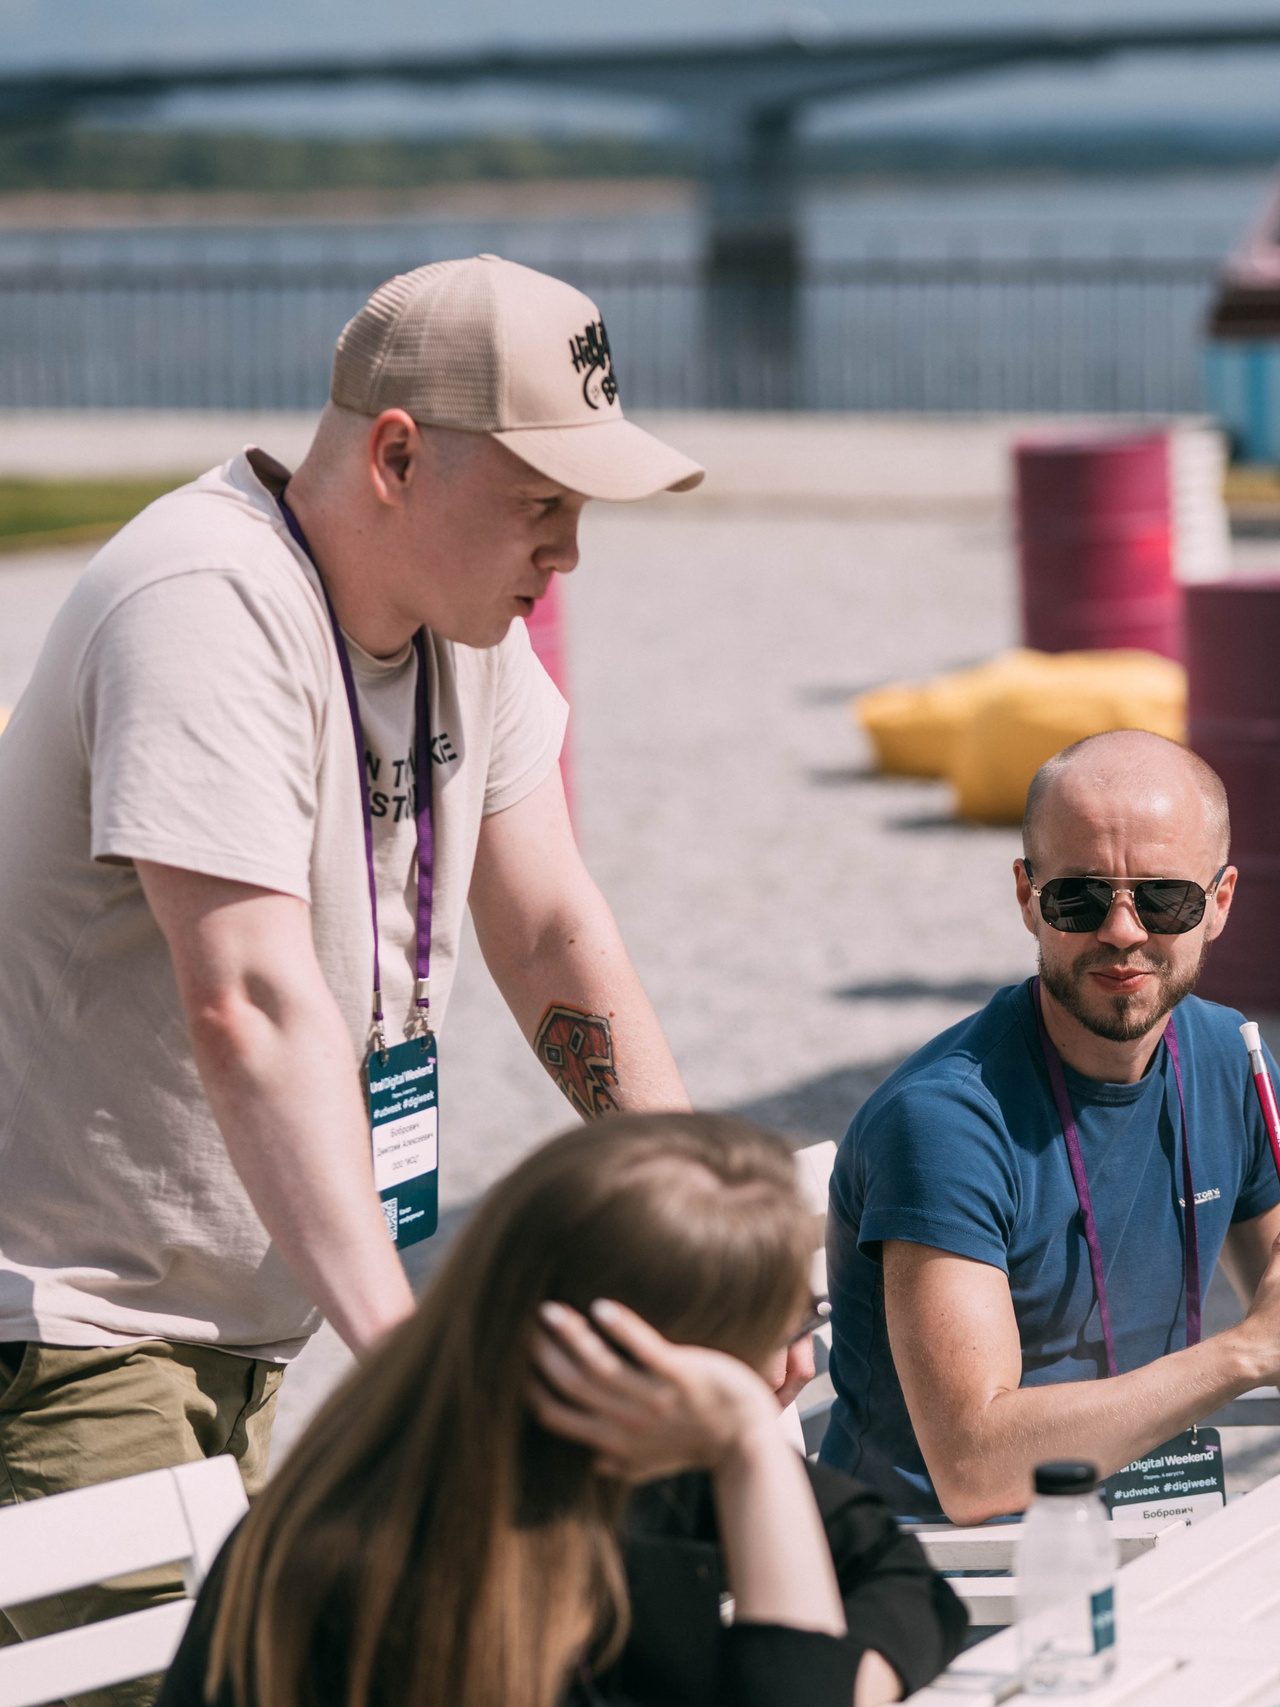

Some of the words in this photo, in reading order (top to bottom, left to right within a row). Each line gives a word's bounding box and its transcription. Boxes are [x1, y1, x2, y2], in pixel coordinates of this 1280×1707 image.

[1130, 1457, 1164, 1473] Digital
[1165, 1450, 1214, 1467] Weekend
[1113, 1485, 1160, 1500] #udweek
[1163, 1477, 1217, 1492] #digiweek
[1143, 1506, 1194, 1519] Бобрович
